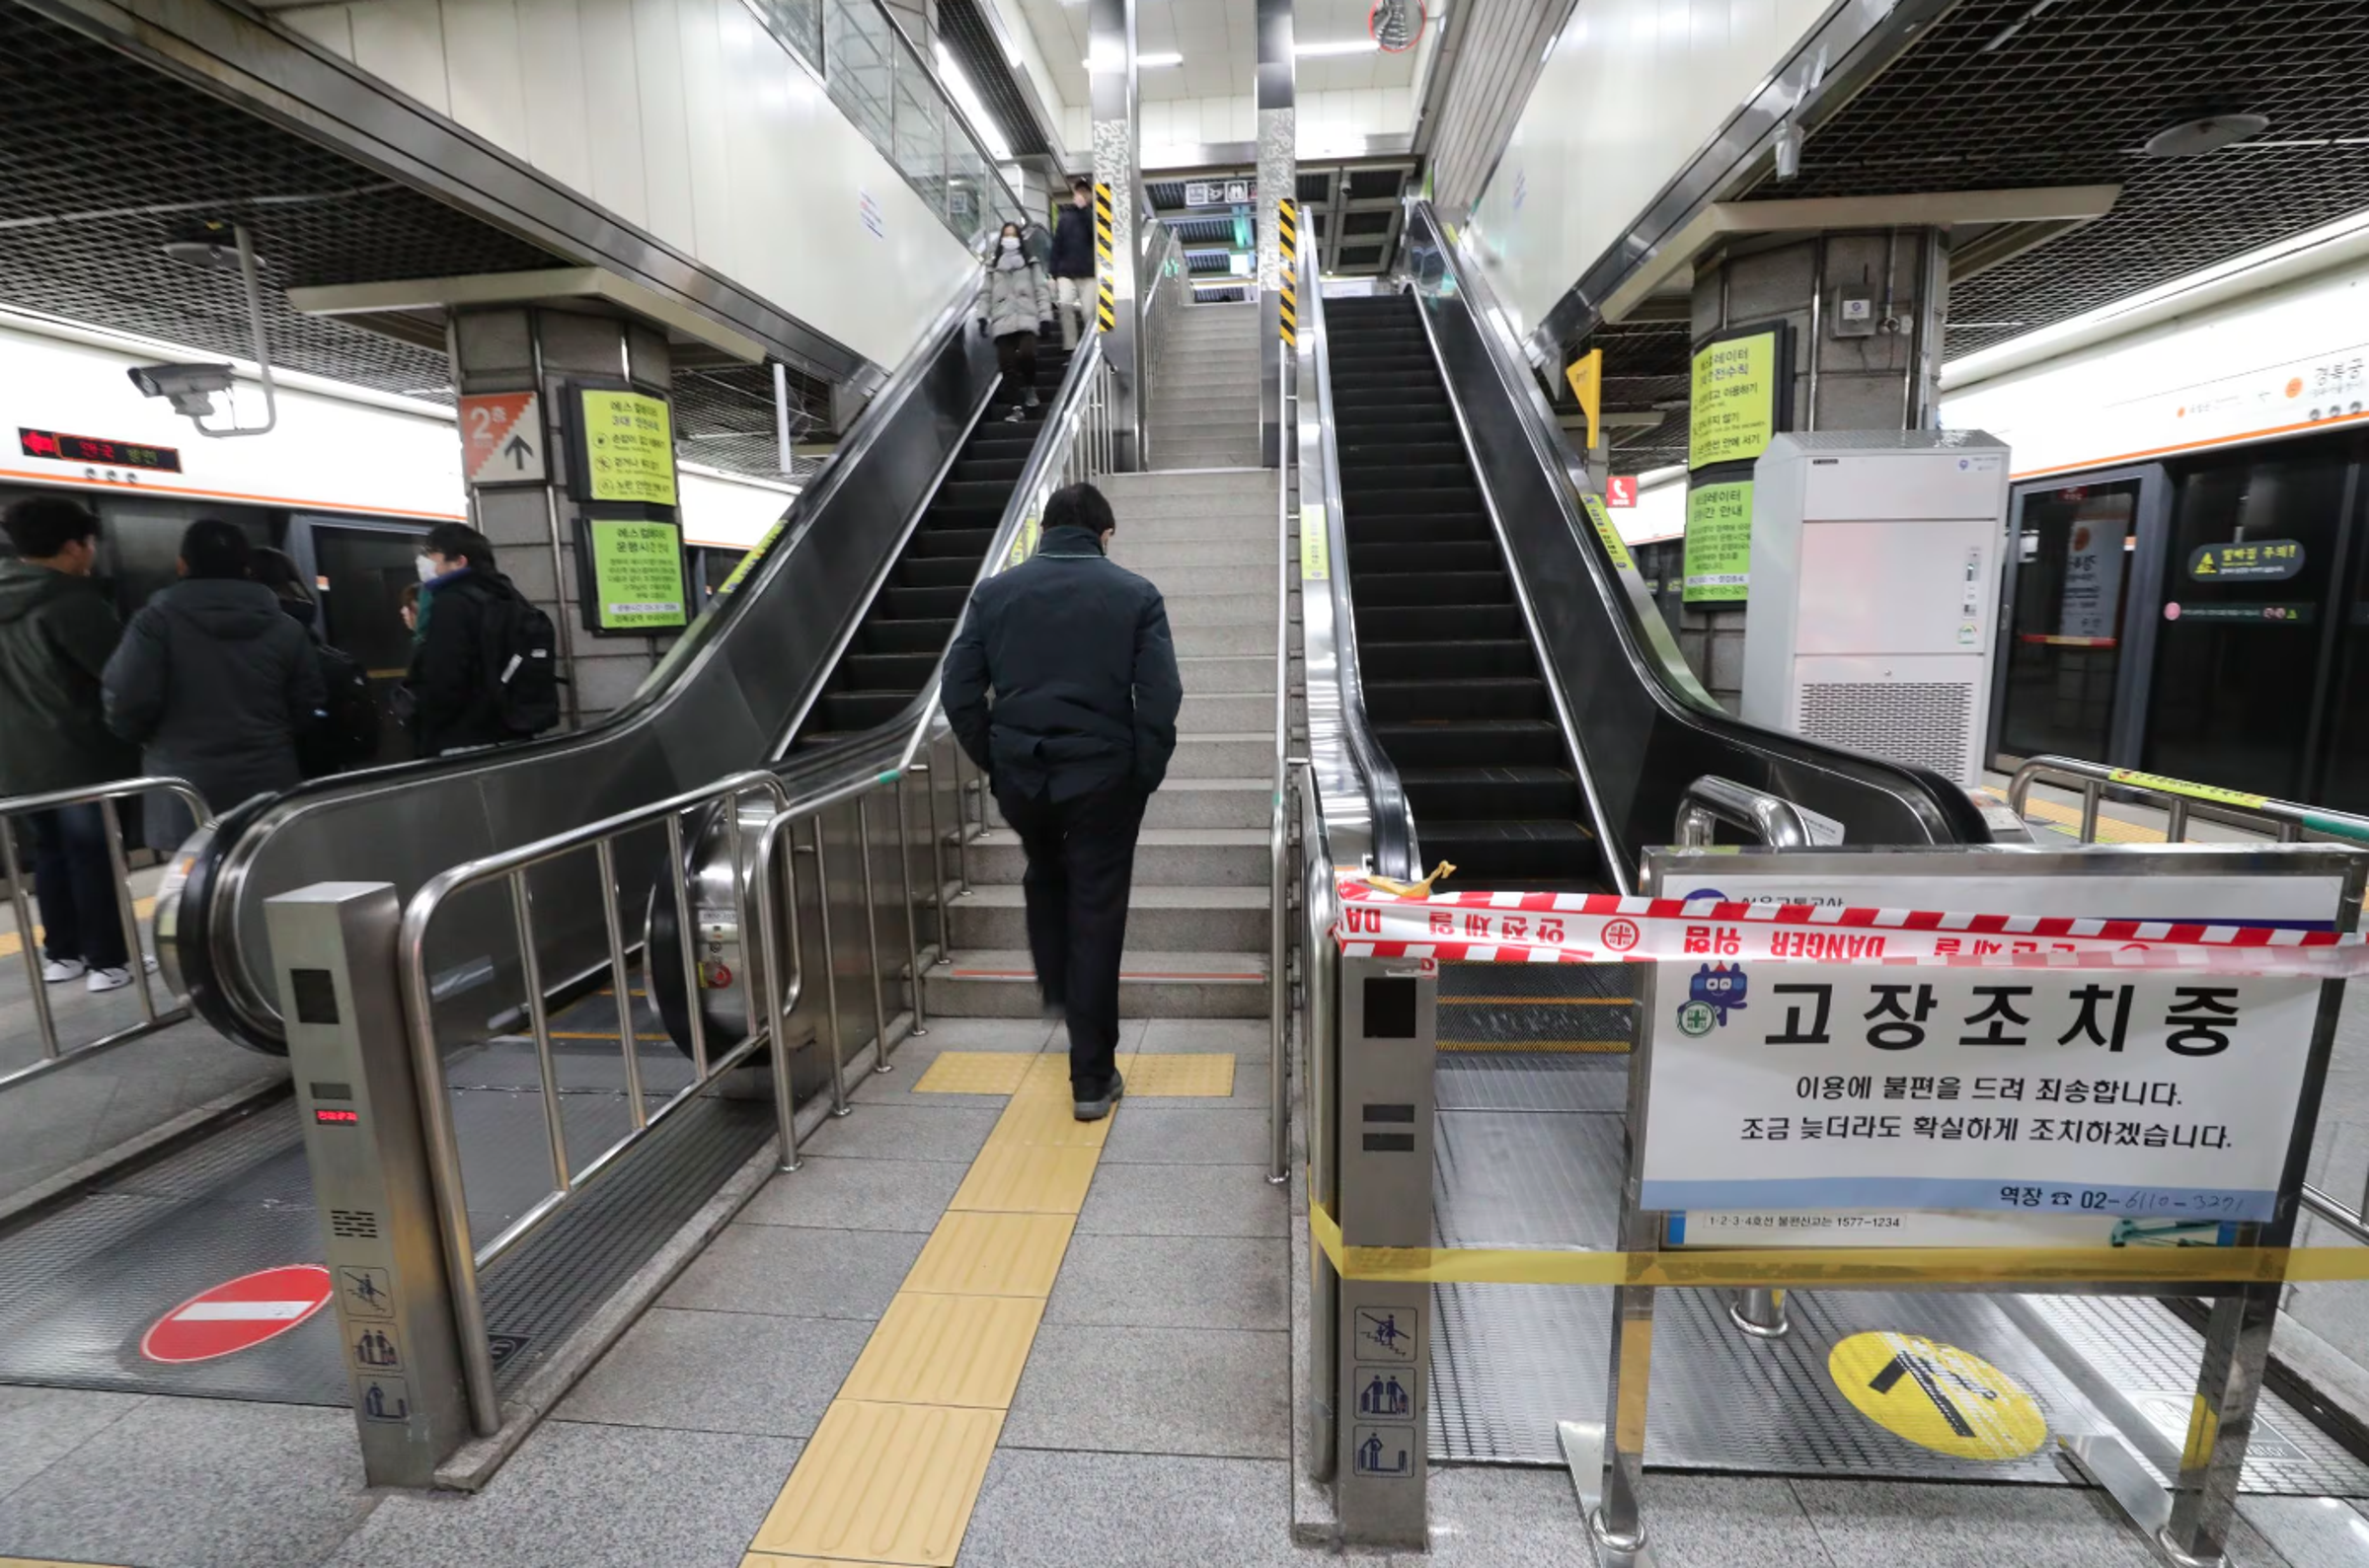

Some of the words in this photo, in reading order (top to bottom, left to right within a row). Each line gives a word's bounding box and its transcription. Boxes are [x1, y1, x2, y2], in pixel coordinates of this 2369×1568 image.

[2315, 358, 2364, 386] 경복궁
[1339, 907, 1381, 933] DA
[1428, 911, 1565, 944] 안전제일
[1684, 926, 1741, 956] 위험
[1770, 931, 1886, 959] DANGER
[1796, 1075, 1872, 1100] 이용에
[1883, 1076, 1962, 1100] 불편을
[1971, 1077, 2025, 1101] 드려
[2035, 1078, 2182, 1107] 죄송합니다.
[1740, 1116, 1791, 1141] 조금
[1799, 1115, 1902, 1141] 늦더라도
[1912, 1115, 2019, 1142] 확실하게
[2028, 1118, 2232, 1150] 조치하겠습니다.
[2000, 1186, 2043, 1207] 역장
[1837, 1216, 1901, 1229] 1577-1234
